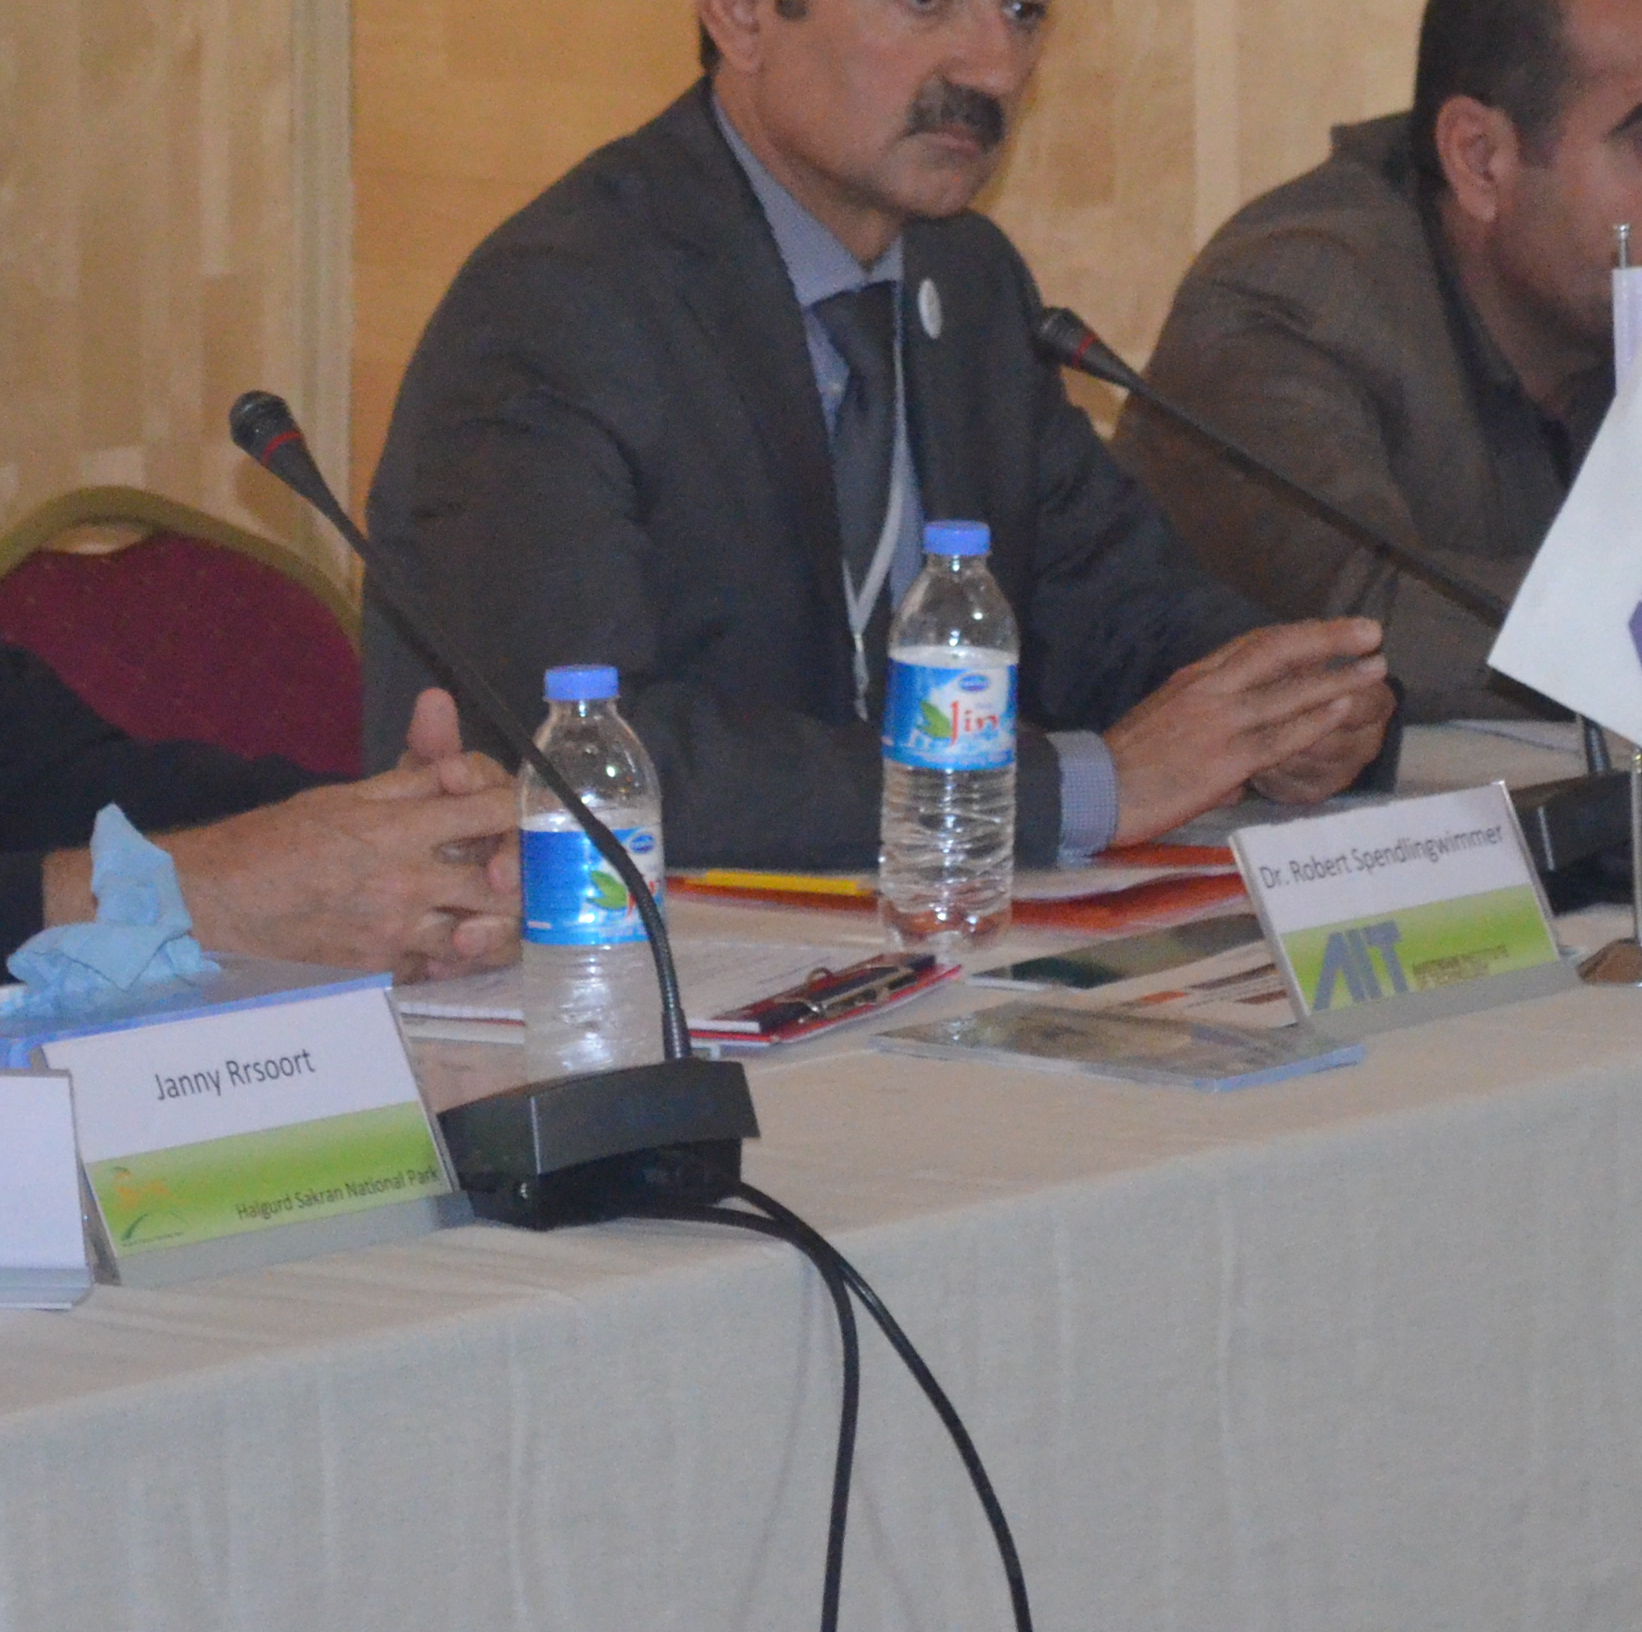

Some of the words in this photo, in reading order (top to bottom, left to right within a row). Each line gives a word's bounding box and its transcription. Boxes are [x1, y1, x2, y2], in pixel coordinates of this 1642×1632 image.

[1260, 865, 1290, 891] Dr.
[1290, 853, 1352, 885] Robert
[1353, 824, 1504, 872] Spendlingwimmer
[1312, 920, 1407, 1011] AIT
[155, 1070, 223, 1102] Janny
[225, 1048, 316, 1087] Rrsoort
[236, 1194, 294, 1221] Halgurd
[294, 1184, 345, 1210] Sakran
[346, 1174, 406, 1201] National
[407, 1166, 441, 1188] Park
